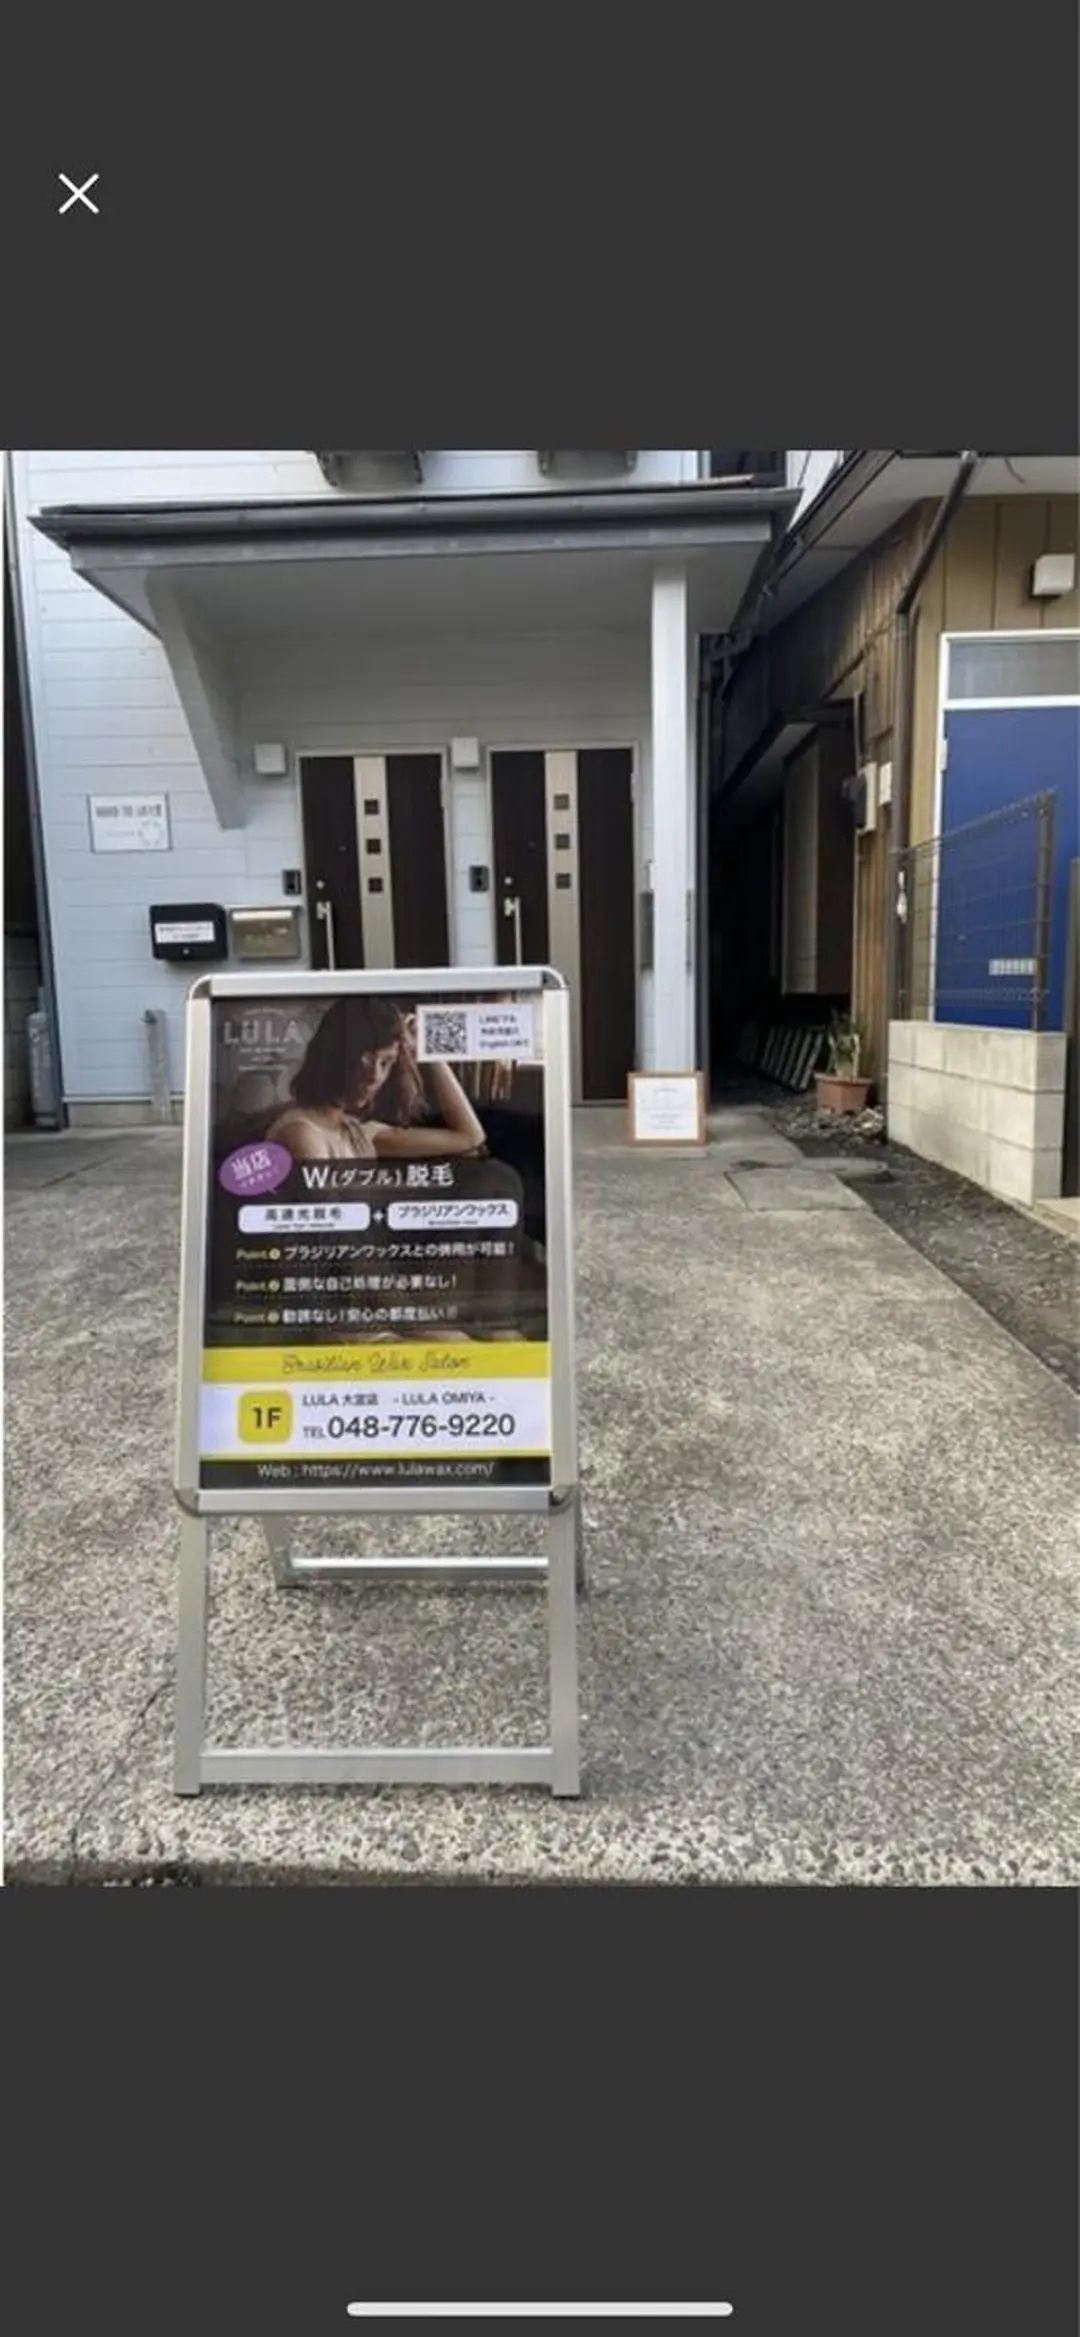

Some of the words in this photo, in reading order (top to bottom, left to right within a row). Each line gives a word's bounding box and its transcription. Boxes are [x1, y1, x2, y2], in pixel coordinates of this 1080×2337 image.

[224, 1020, 303, 1045] LULA
[398, 1203, 509, 1218] ブラジリアンワックス
[302, 1393, 339, 1406] LULA
[402, 1392, 438, 1405] LULA
[442, 1391, 486, 1404] OMIYA
[252, 1406, 282, 1429] 1F
[328, 1413, 515, 1439] 048-776-9220
[257, 1464, 292, 1478] Web
